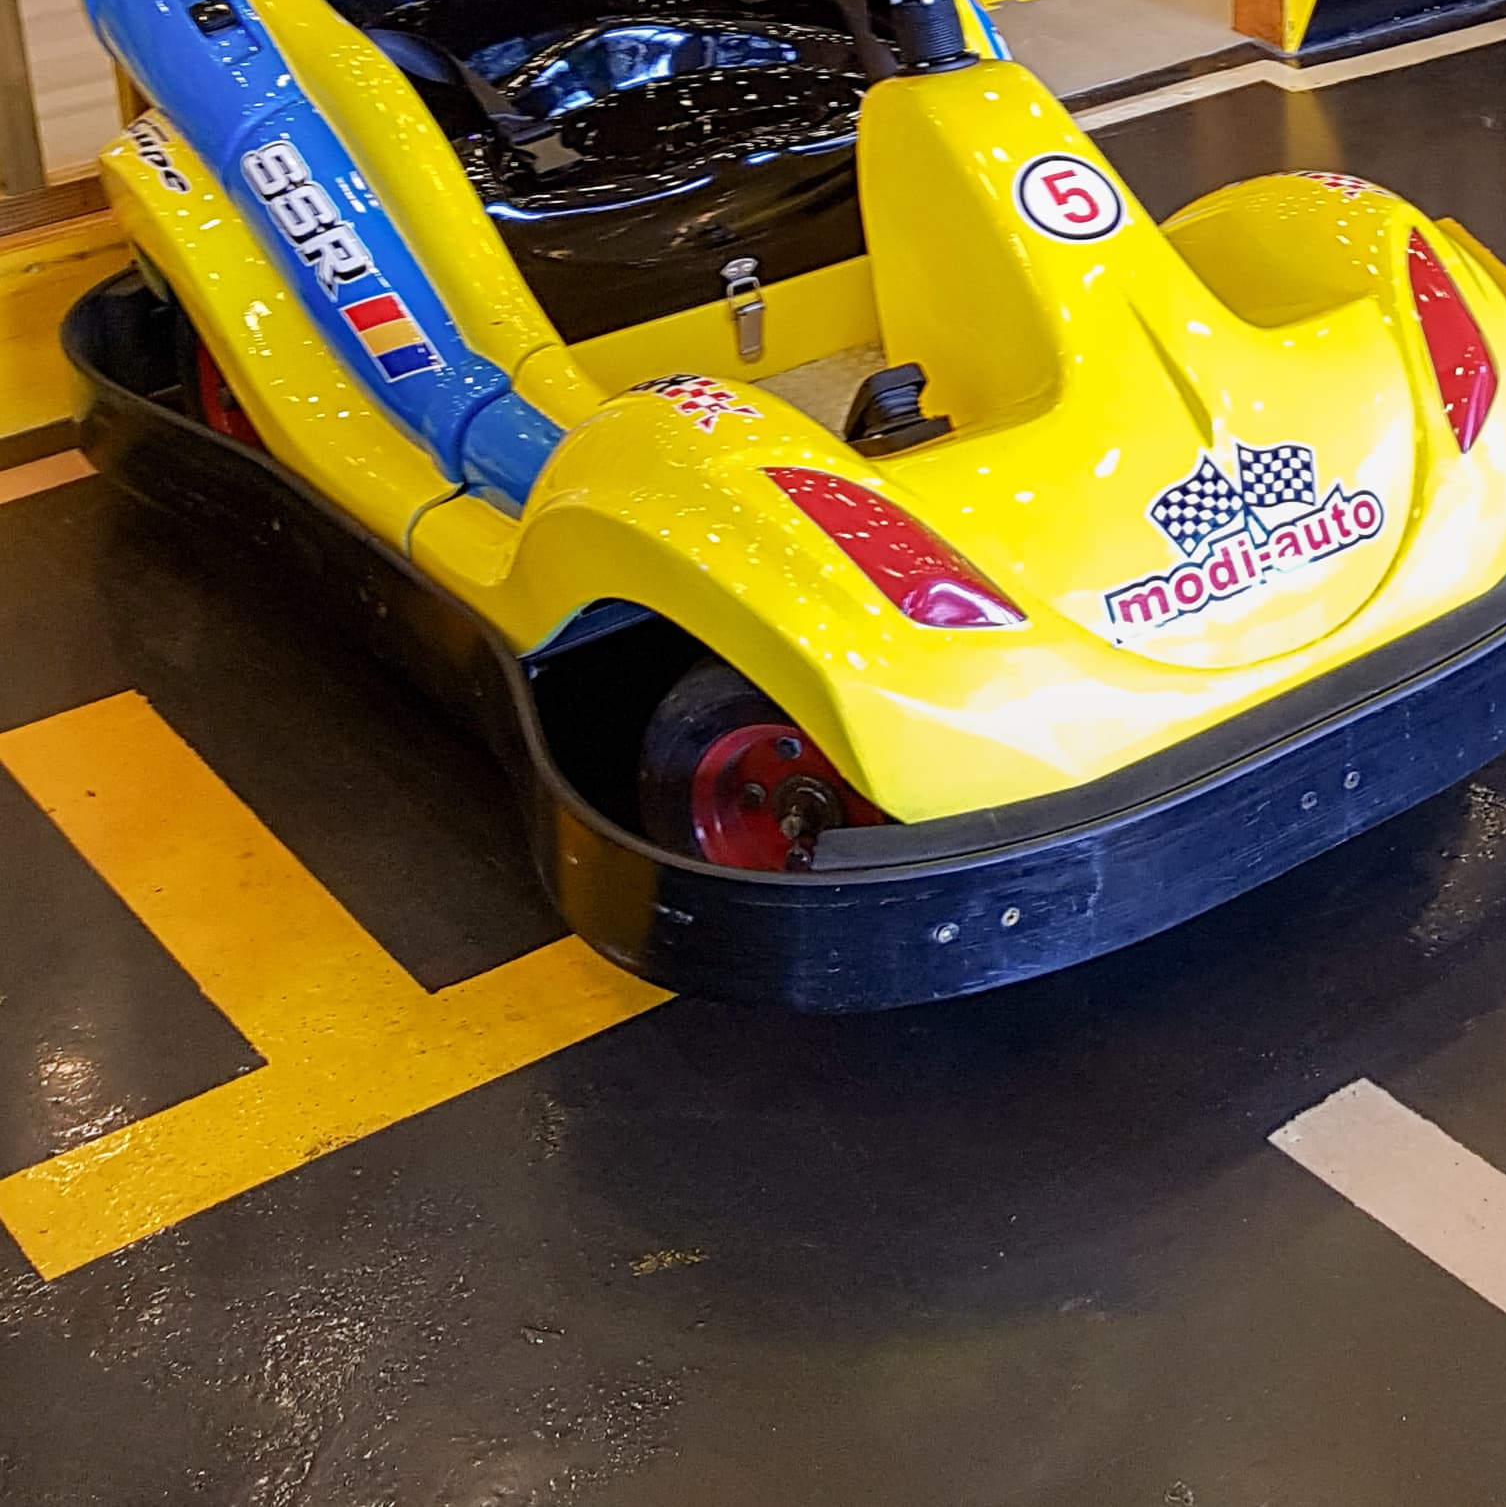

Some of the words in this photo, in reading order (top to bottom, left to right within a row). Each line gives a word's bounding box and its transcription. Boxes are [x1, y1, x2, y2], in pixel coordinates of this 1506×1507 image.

[240, 140, 374, 303] SSR
[1040, 169, 1100, 224] 5
[1116, 498, 1378, 625] modi-auto
